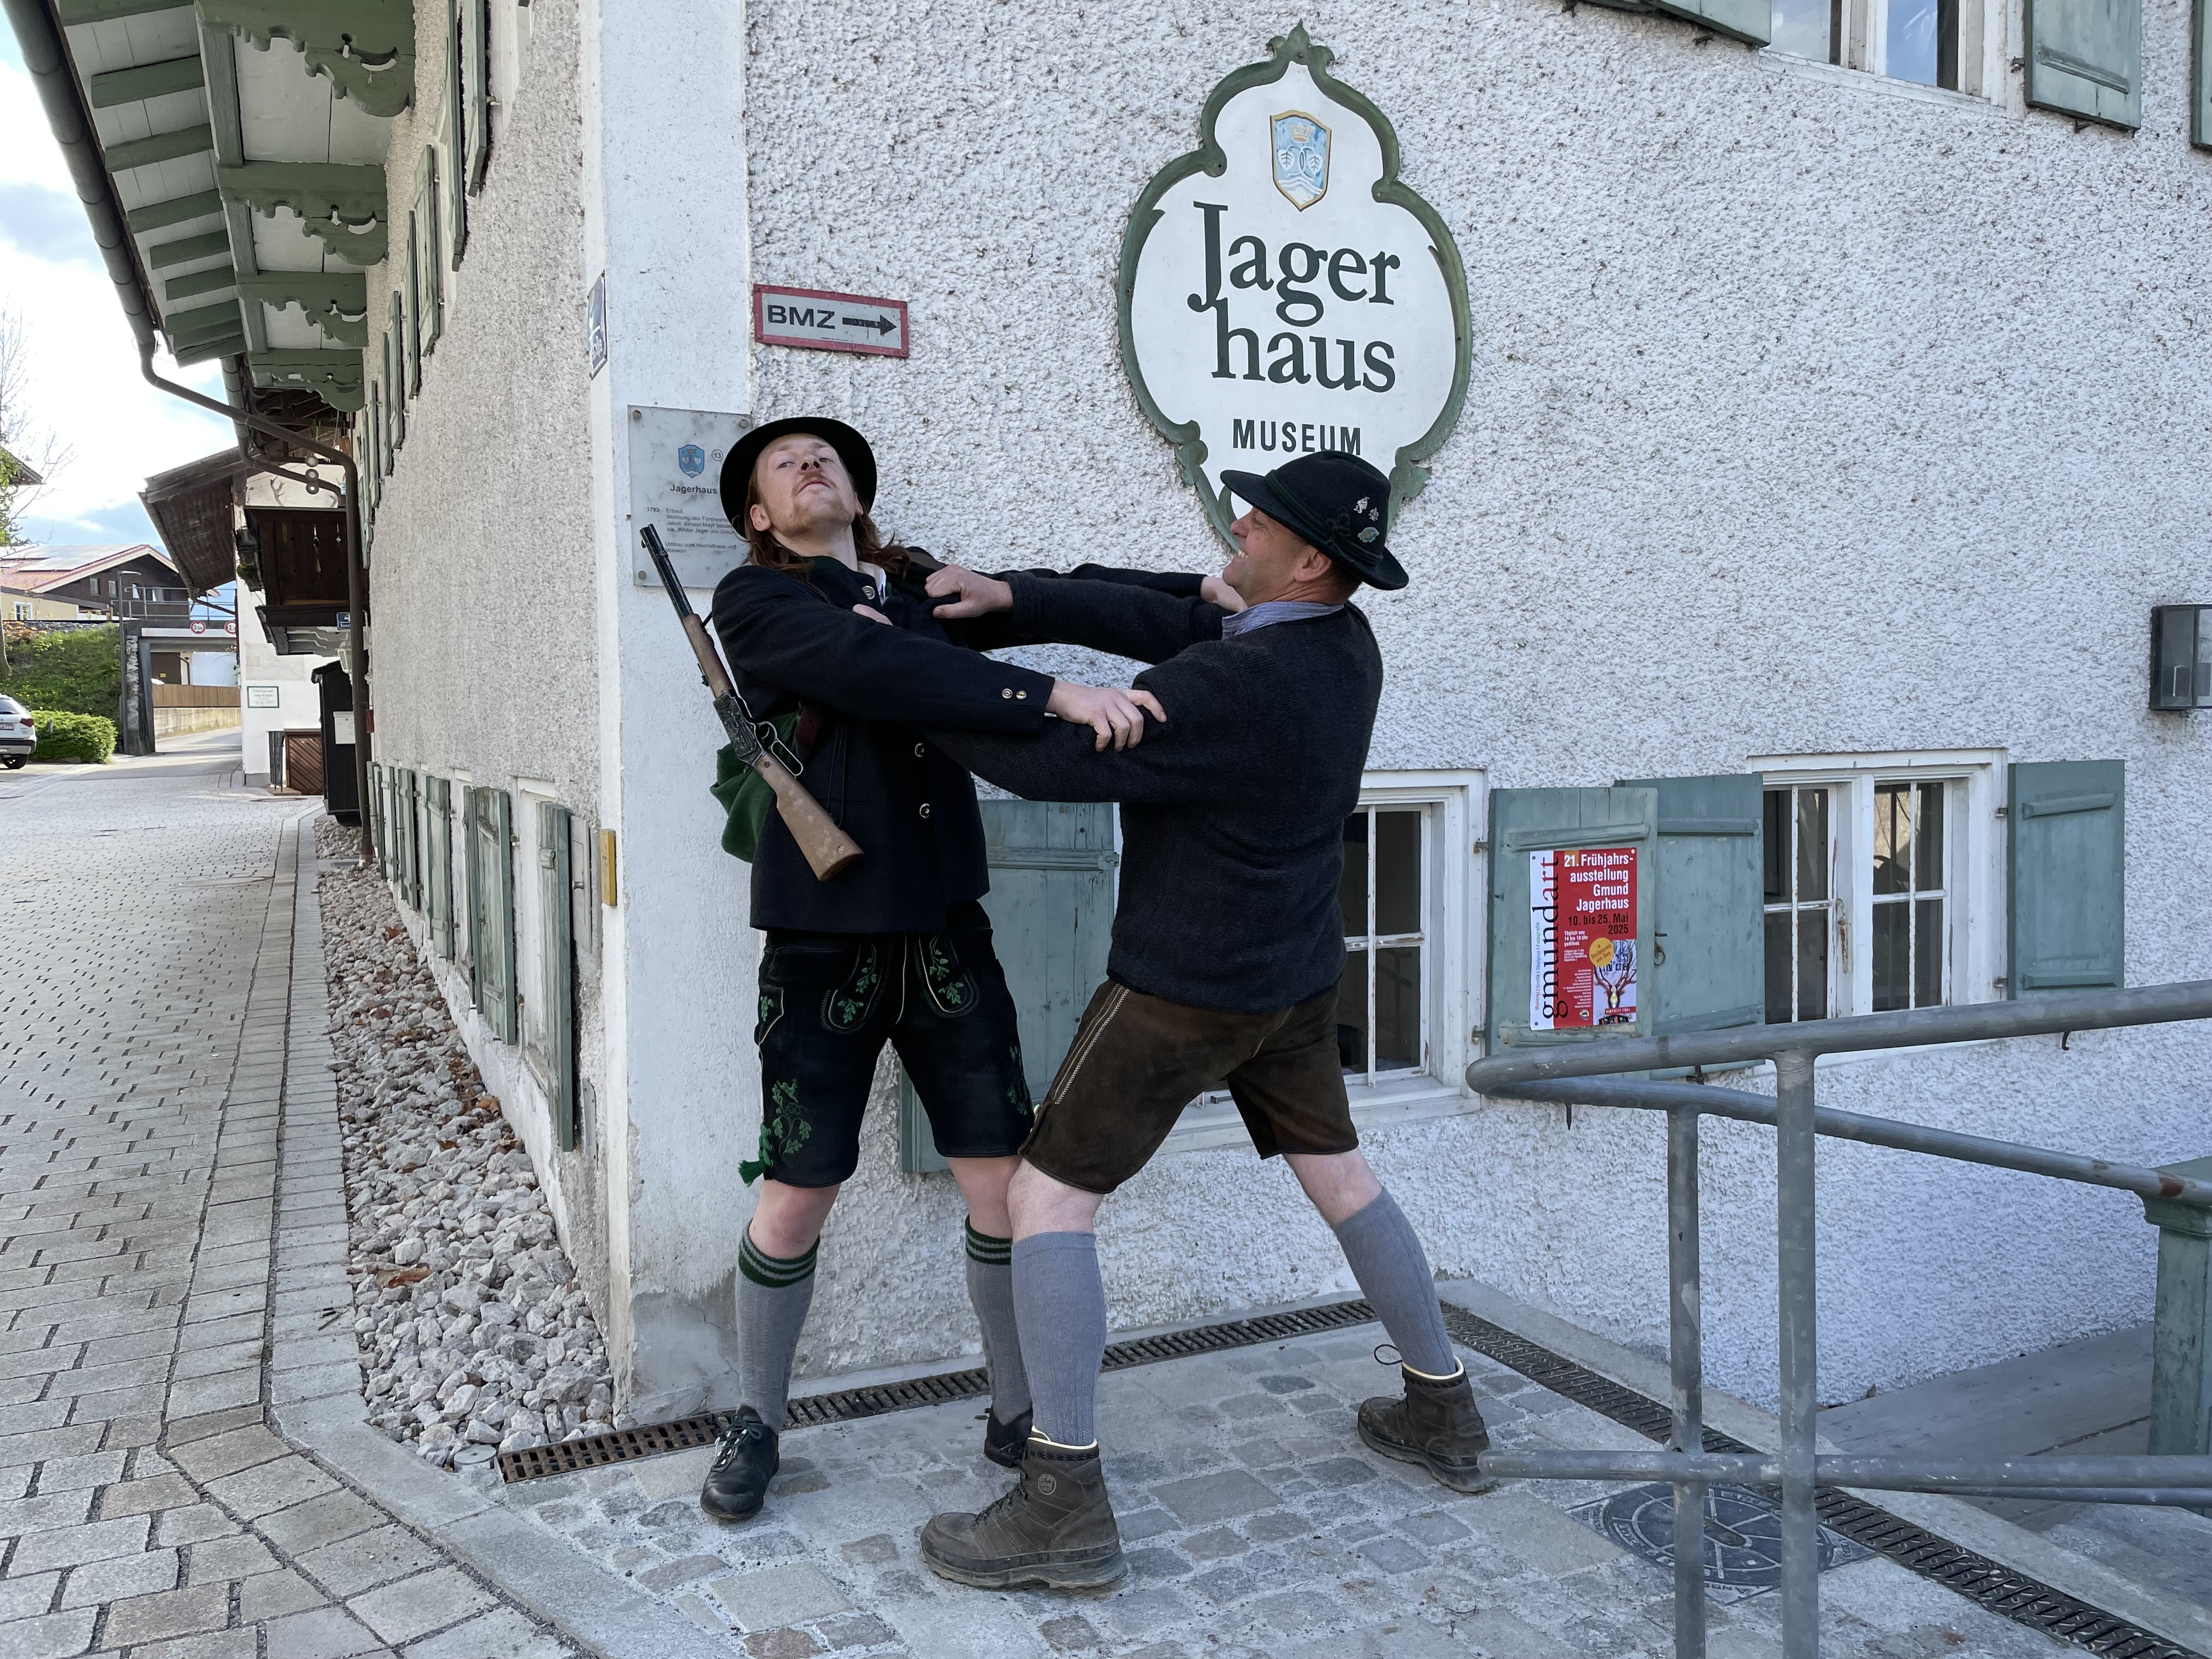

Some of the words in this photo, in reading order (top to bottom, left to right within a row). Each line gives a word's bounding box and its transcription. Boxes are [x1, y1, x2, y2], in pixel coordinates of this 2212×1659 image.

[1187, 200, 1401, 328] Jager
[768, 304, 836, 329] BMZ
[1211, 297, 1396, 393] haus
[1233, 418, 1361, 456] MUSEUM
[670, 484, 718, 494] Jagerhaus
[1564, 855, 1579, 867] 21.
[1581, 853, 1634, 868] Frühjahrs-
[1570, 868, 1628, 882] ausstellung
[1593, 883, 1628, 896] Gmund
[1576, 898, 1629, 913] Jagerhaus
[1567, 915, 1581, 926] 10.
[1583, 915, 1595, 924] bis
[1598, 913, 1611, 924] 25.
[1613, 912, 1628, 923] Mai
[1608, 924, 1628, 934] 2025
[1531, 857, 1568, 1019] gmundart
